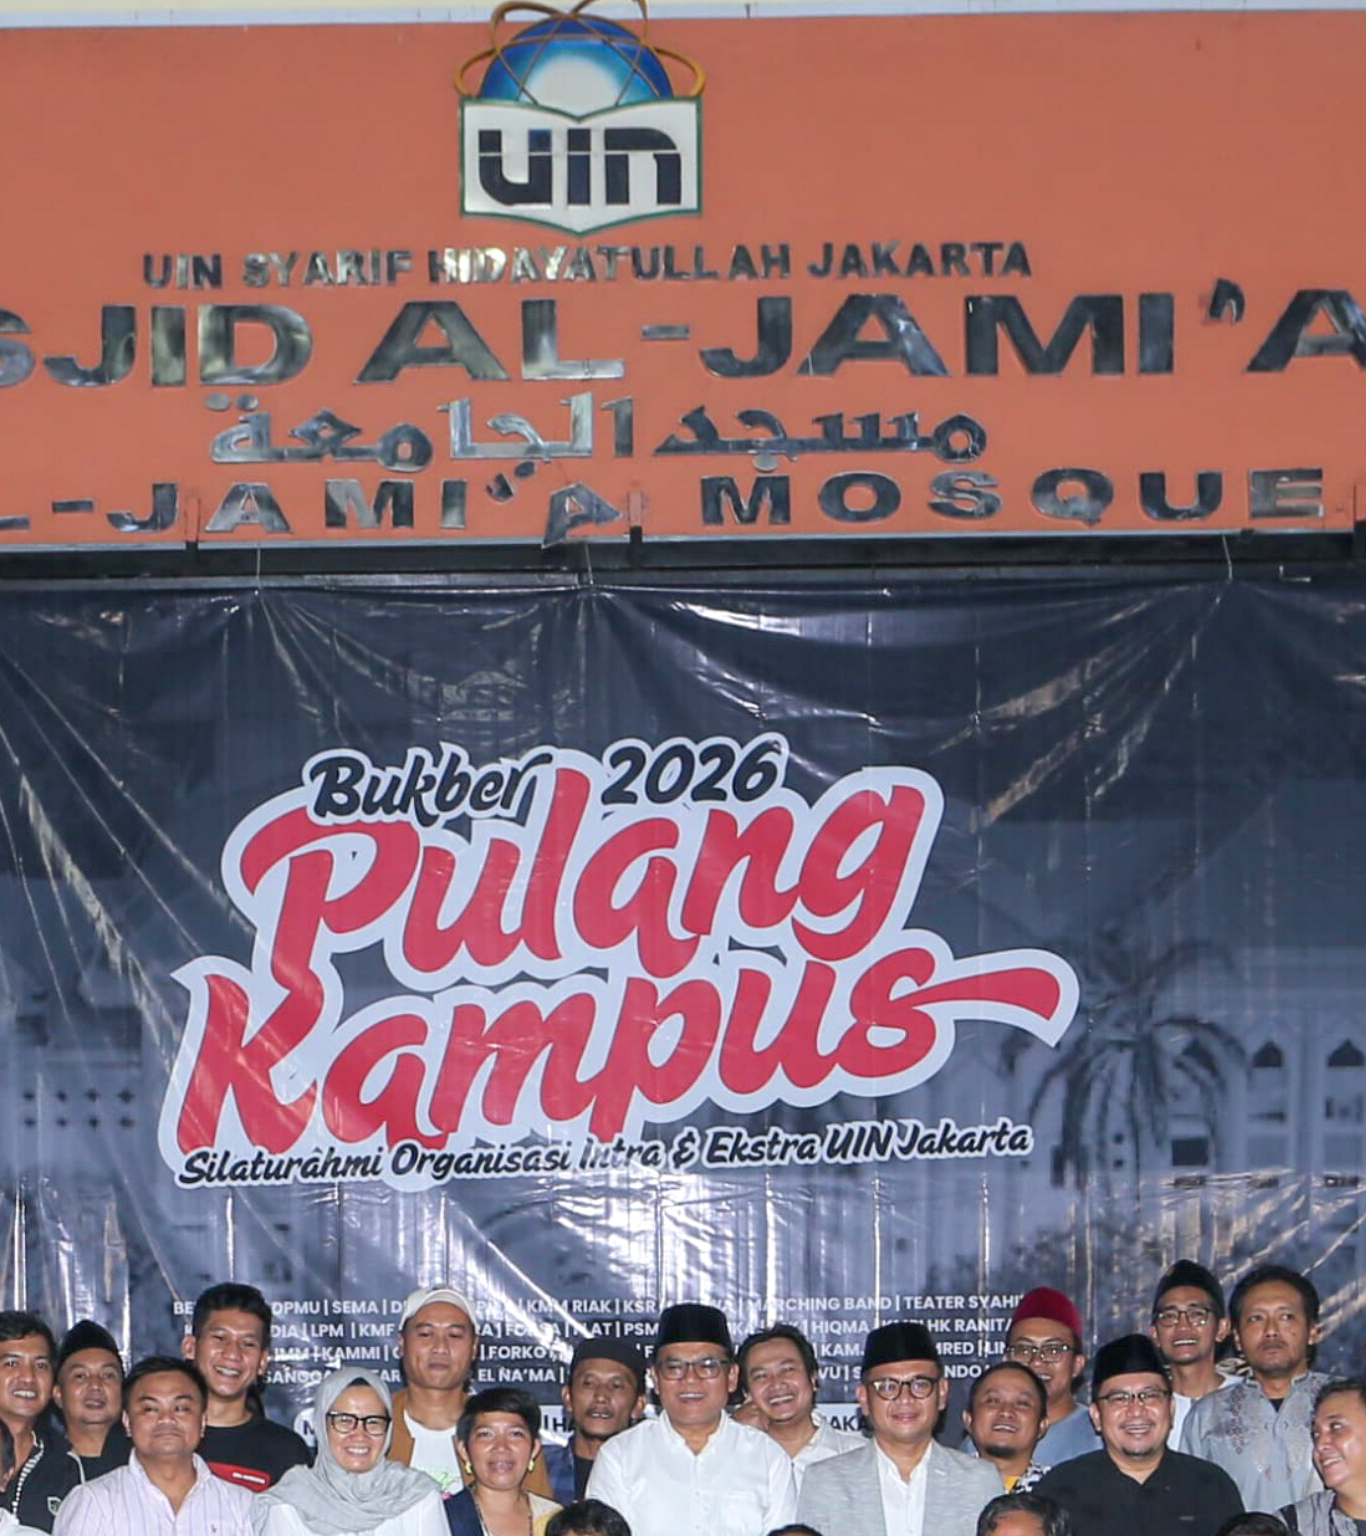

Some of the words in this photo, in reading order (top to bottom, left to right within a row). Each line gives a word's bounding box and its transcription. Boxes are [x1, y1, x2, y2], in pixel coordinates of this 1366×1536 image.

[141, 252, 223, 289] UIN
[242, 249, 412, 287] SYARIF
[428, 243, 791, 285] HIDAYATULLAH
[808, 241, 1033, 278] JAKARTA
[701, 467, 1324, 526] MOSQUE
[309, 752, 553, 828] Bukber
[601, 739, 780, 805] 2026
[239, 766, 926, 990] Pulang
[176, 947, 1061, 1154] Kampus
[179, 1146, 382, 1183] Silaturahmi
[392, 1140, 571, 1180] Organisasi
[578, 1136, 663, 1170] Intra
[673, 1129, 696, 1167] &
[707, 1126, 817, 1164] Ekstra
[827, 1121, 891, 1158] UIN
[899, 1119, 1031, 1157] Jakarta
[332, 1300, 378, 1314] SEMA
[572, 1299, 611, 1313] RIAK
[623, 1299, 656, 1313] KSR
[750, 1298, 840, 1312] MARCHING
[844, 1297, 892, 1311] BAND
[904, 1296, 967, 1310] TEATER
[311, 1323, 344, 1337] LPM
[359, 1323, 395, 1337] KMF
[623, 1322, 659, 1337] PSM
[812, 1320, 869, 1336] HIQMA
[322, 1346, 380, 1361] KAMMI
[478, 1369, 495, 1383] EL
